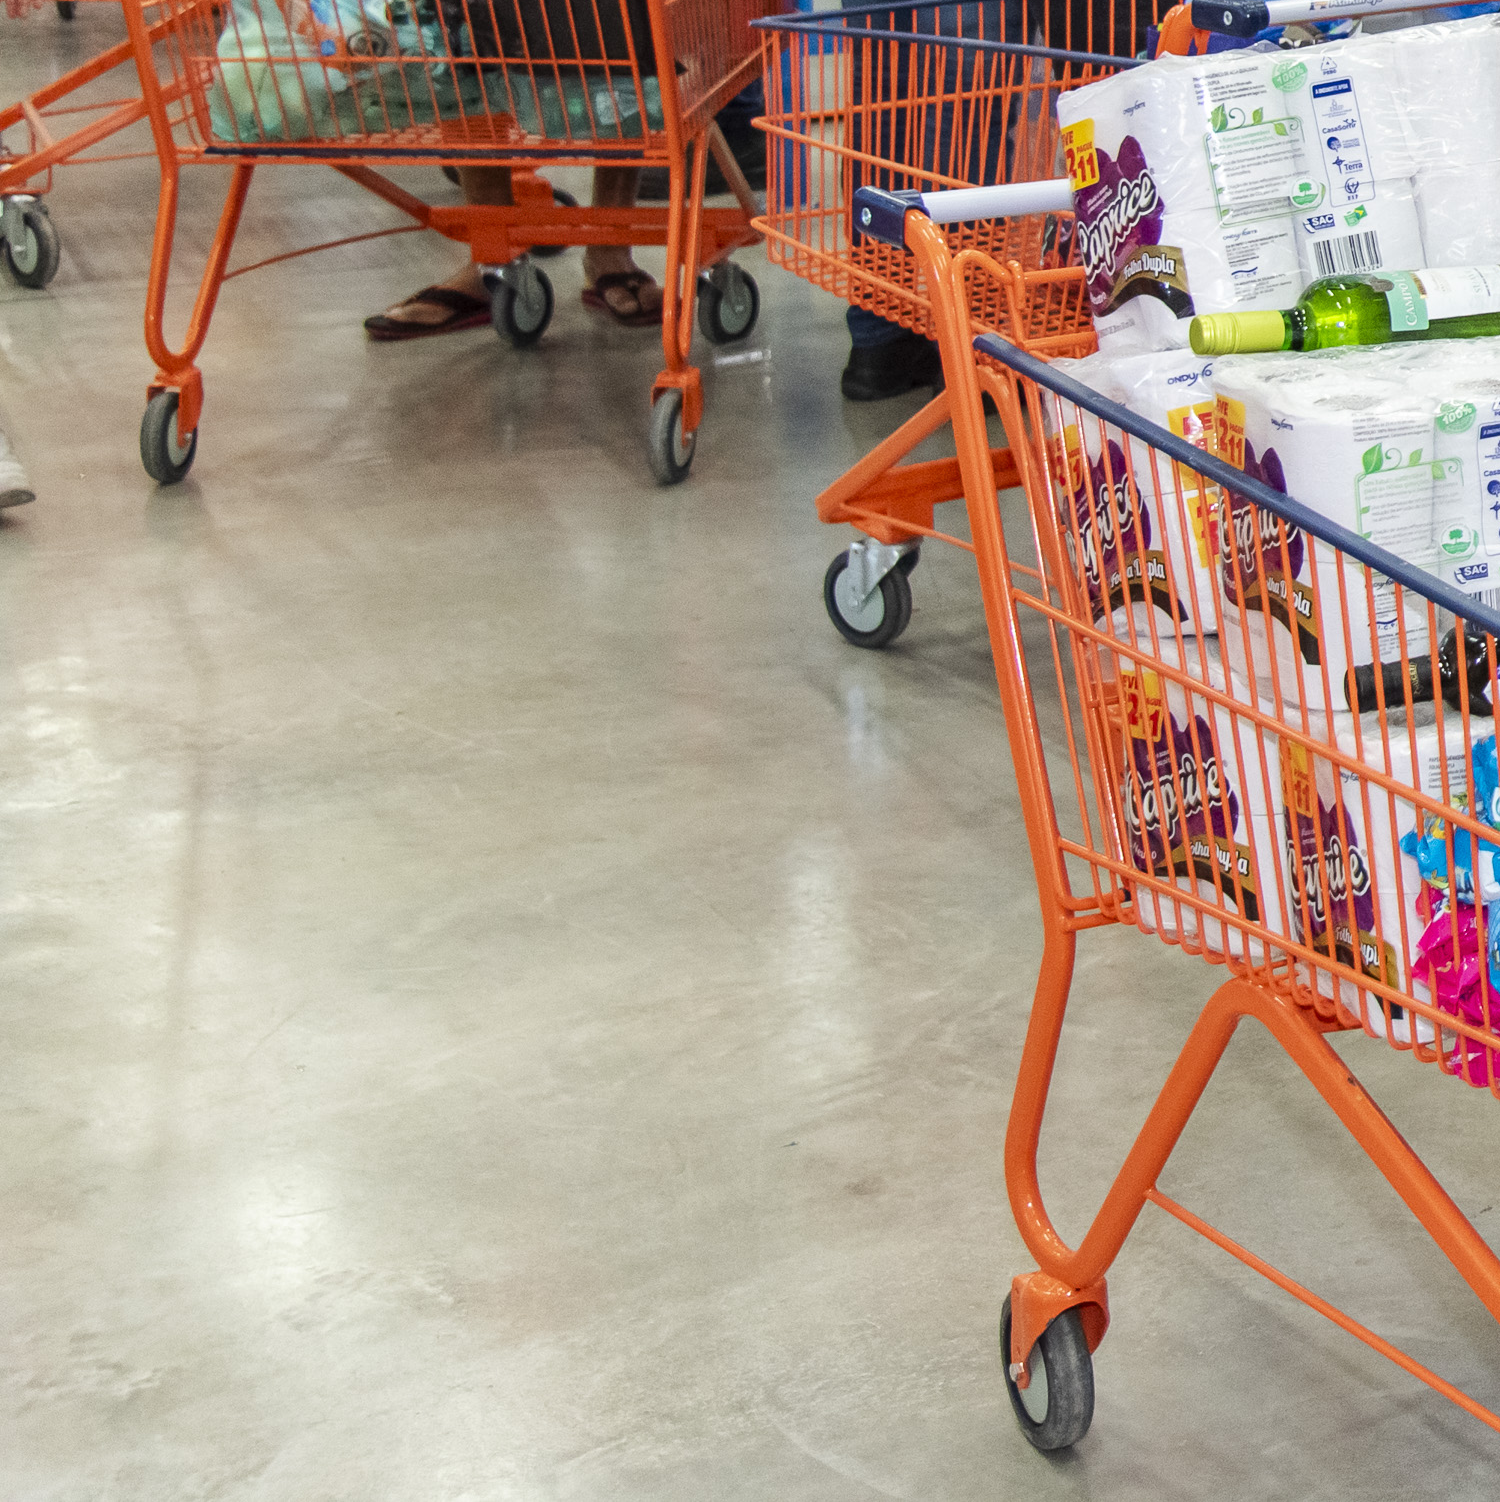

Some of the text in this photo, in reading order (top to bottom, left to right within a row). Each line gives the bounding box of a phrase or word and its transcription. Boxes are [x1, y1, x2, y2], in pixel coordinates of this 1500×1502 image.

[1276, 65, 1307, 86] 100%
[1322, 121, 1357, 135] CasaSorrir
[1077, 141, 1092, 154] PAGUE
[1078, 151, 1098, 184] 11
[1344, 160, 1363, 172] Terra
[1078, 169, 1157, 286] Caprice
[1311, 215, 1335, 226] SAC
[1142, 252, 1176, 276] Dupla
[1442, 406, 1473, 425] 100%
[1464, 564, 1488, 576] SAC
